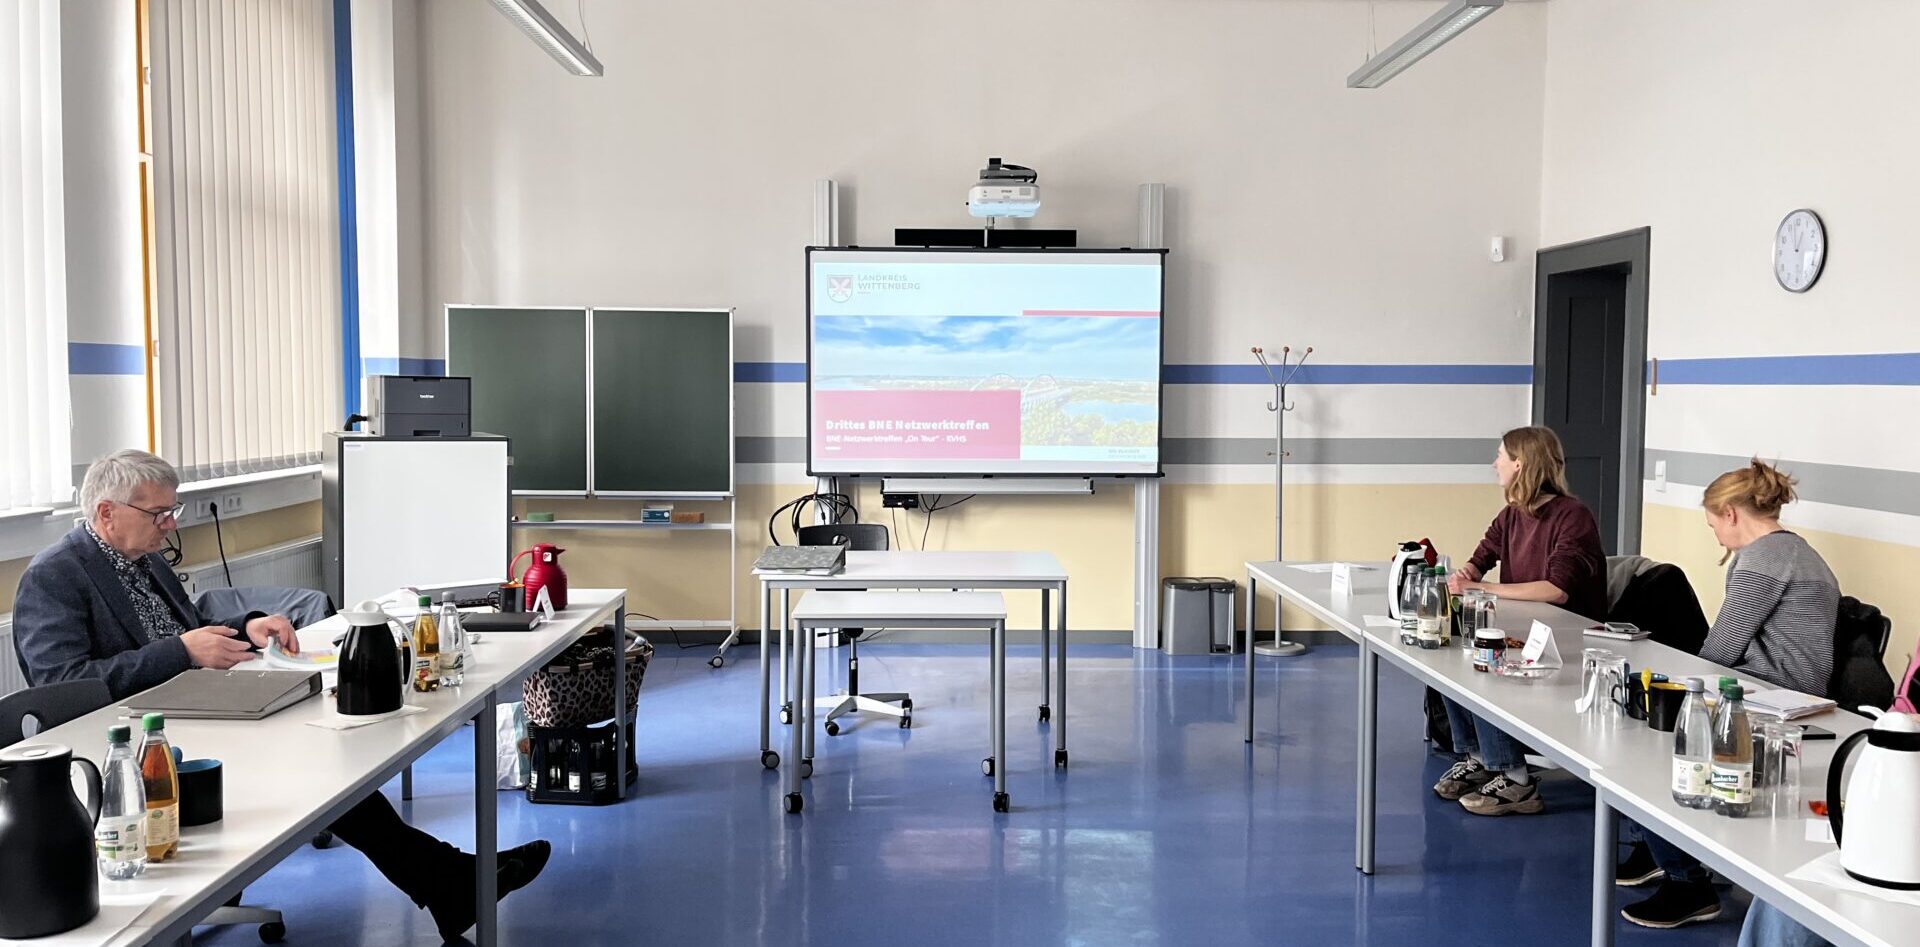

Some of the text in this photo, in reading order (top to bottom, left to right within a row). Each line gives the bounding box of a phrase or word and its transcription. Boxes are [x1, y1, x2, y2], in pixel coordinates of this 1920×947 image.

[857, 282, 920, 290] WITTENBERG
[825, 419, 990, 430] Drittes BNE Netzwerktreffen
